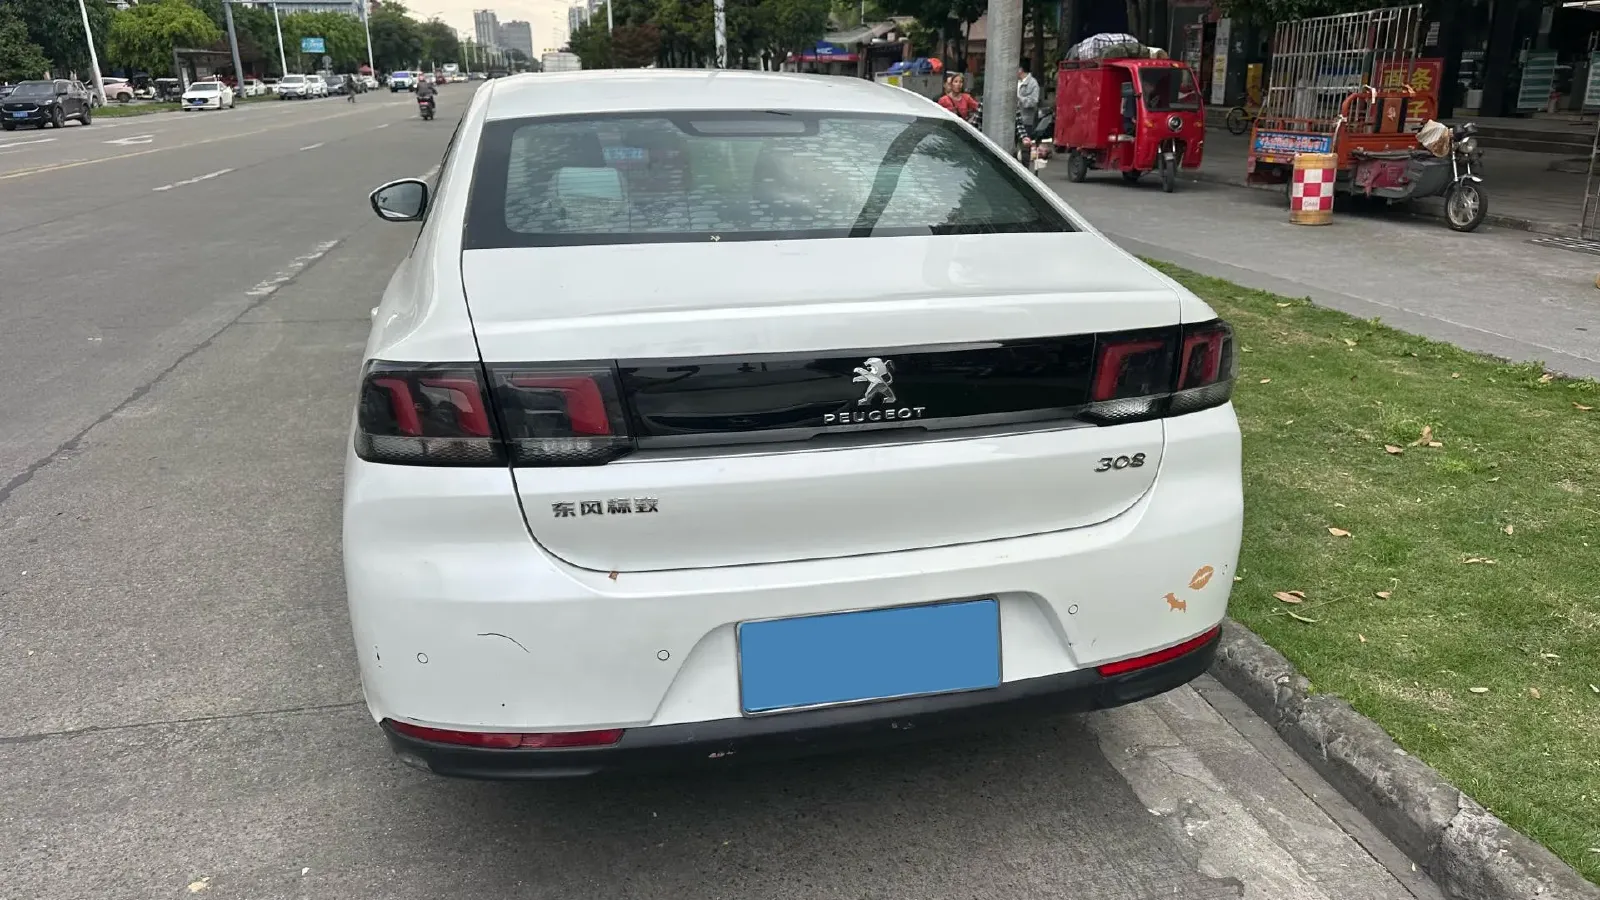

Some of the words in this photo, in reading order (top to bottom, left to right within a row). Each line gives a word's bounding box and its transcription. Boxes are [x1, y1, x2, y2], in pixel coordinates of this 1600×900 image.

[824, 407, 926, 424] PEUGEOT
[1094, 453, 1146, 472] 308
[552, 498, 659, 517] 东风标致
